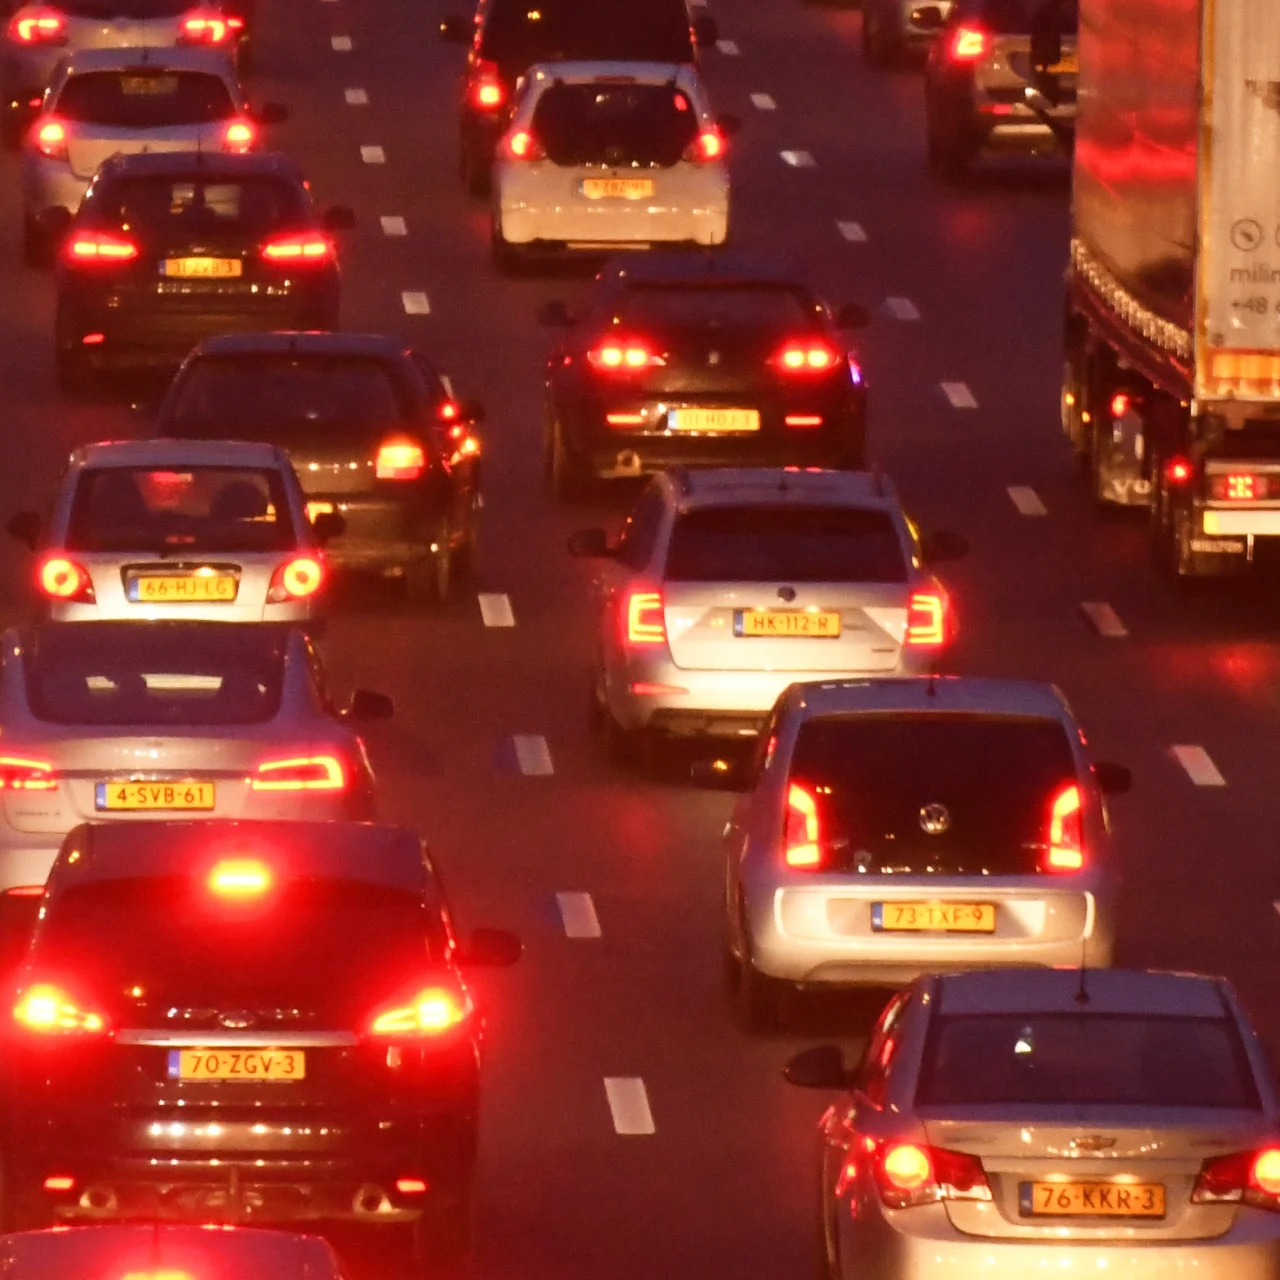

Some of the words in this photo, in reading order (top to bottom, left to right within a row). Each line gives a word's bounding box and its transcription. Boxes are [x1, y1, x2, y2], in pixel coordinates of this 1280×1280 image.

[753, 615, 828, 631] HK-112-R
[116, 786, 204, 804] 4-SVB-61
[893, 906, 983, 925] 73-TXF-9
[190, 1054, 295, 1075] 70-ZGV-3
[1042, 1186, 1155, 1210] 76-KKR-3
